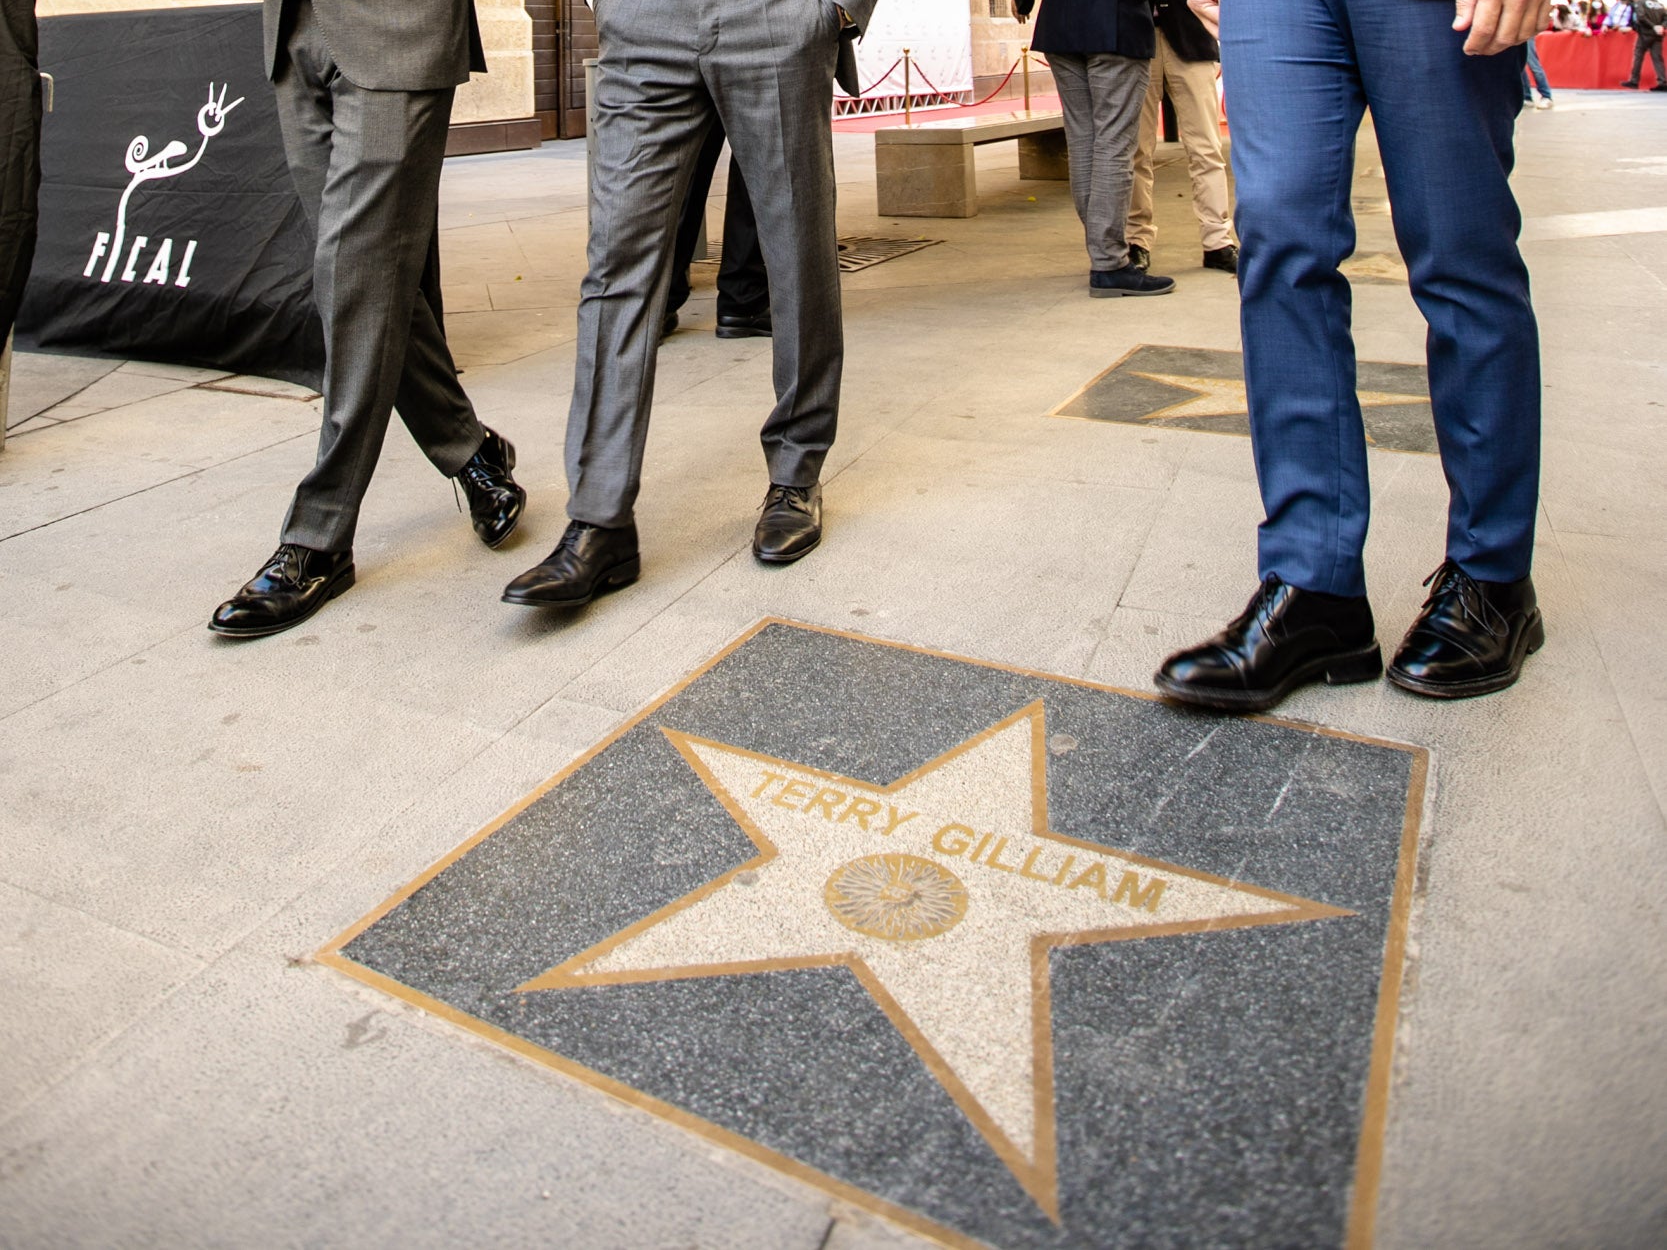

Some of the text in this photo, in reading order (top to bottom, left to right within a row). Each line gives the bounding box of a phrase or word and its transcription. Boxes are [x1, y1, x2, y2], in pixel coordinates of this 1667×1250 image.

[83, 231, 198, 288] FICAL
[750, 771, 1167, 914] TERRY GILLIAM
